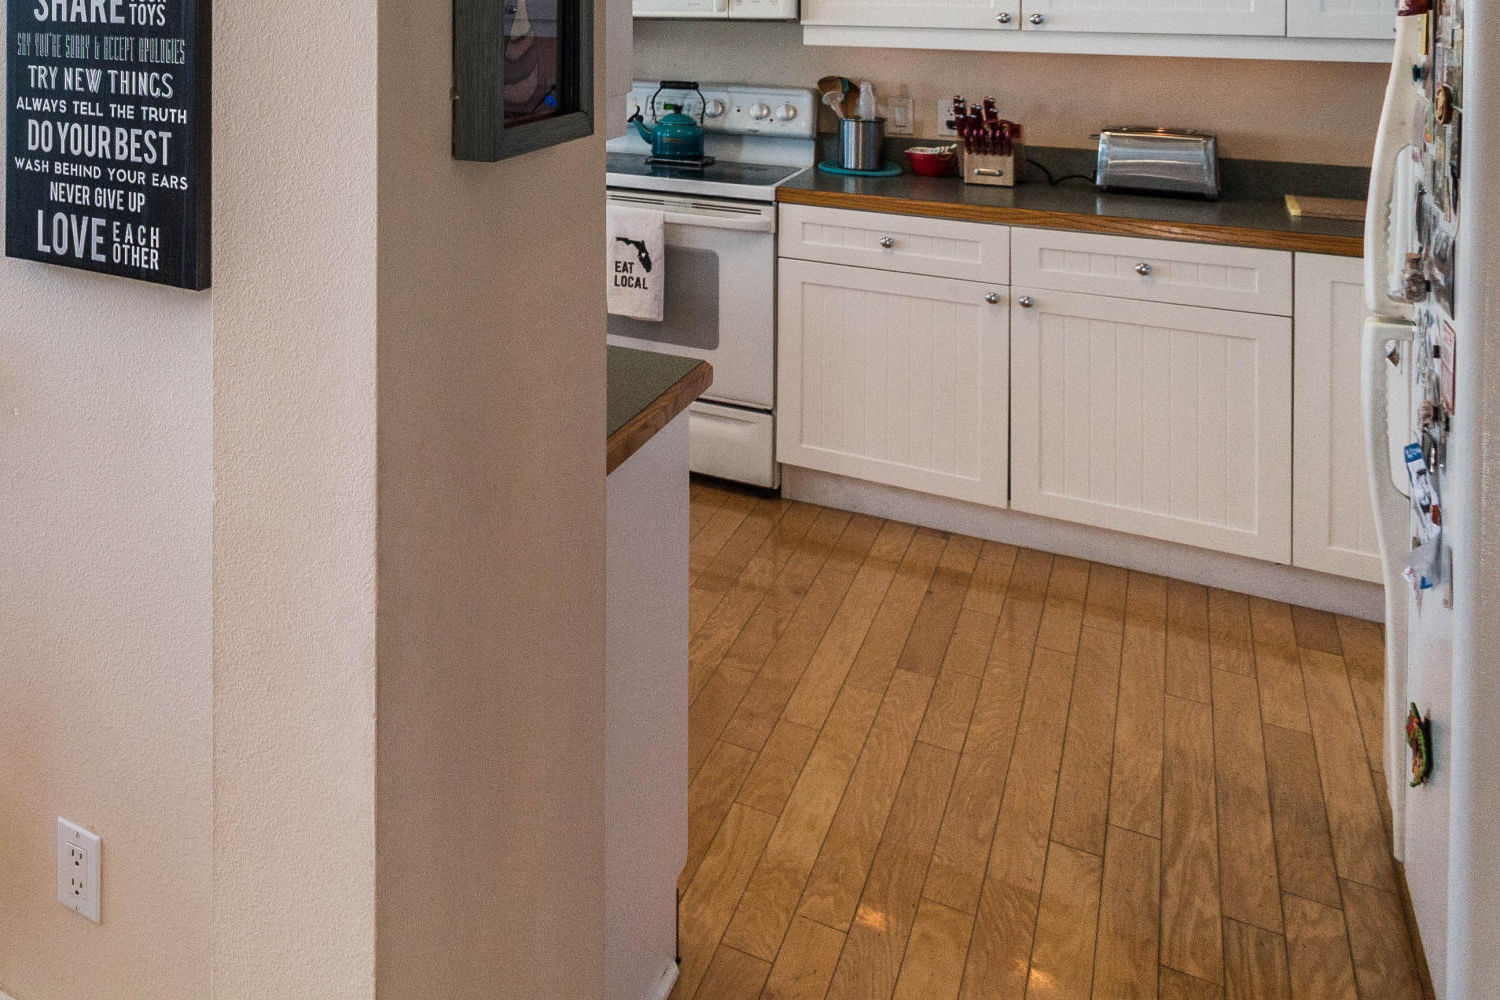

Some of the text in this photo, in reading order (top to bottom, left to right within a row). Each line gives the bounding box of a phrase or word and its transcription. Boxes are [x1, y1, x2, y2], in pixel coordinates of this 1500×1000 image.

[129, 4, 165, 26] TOYS
[18, 32, 31, 55] SAY
[66, 34, 90, 58] SORRY
[95, 36, 99, 59] &
[104, 36, 134, 61] ACCEPT
[139, 37, 185, 64] APOLOGIES
[29, 65, 173, 99] TRY NEW THINGS
[17, 97, 187, 124] ALWAYS TELL THE TRUTH
[28, 119, 172, 165] DO YOUR BEST
[15, 157, 187, 190] WASH BEHIND YOUR EARS
[51, 182, 145, 213] NEVER GIVE UP
[38, 210, 159, 262] LOVE EACH
[113, 244, 159, 270] OTHER
[615, 261, 634, 273] EAT
[615, 275, 648, 289] LOCAL
